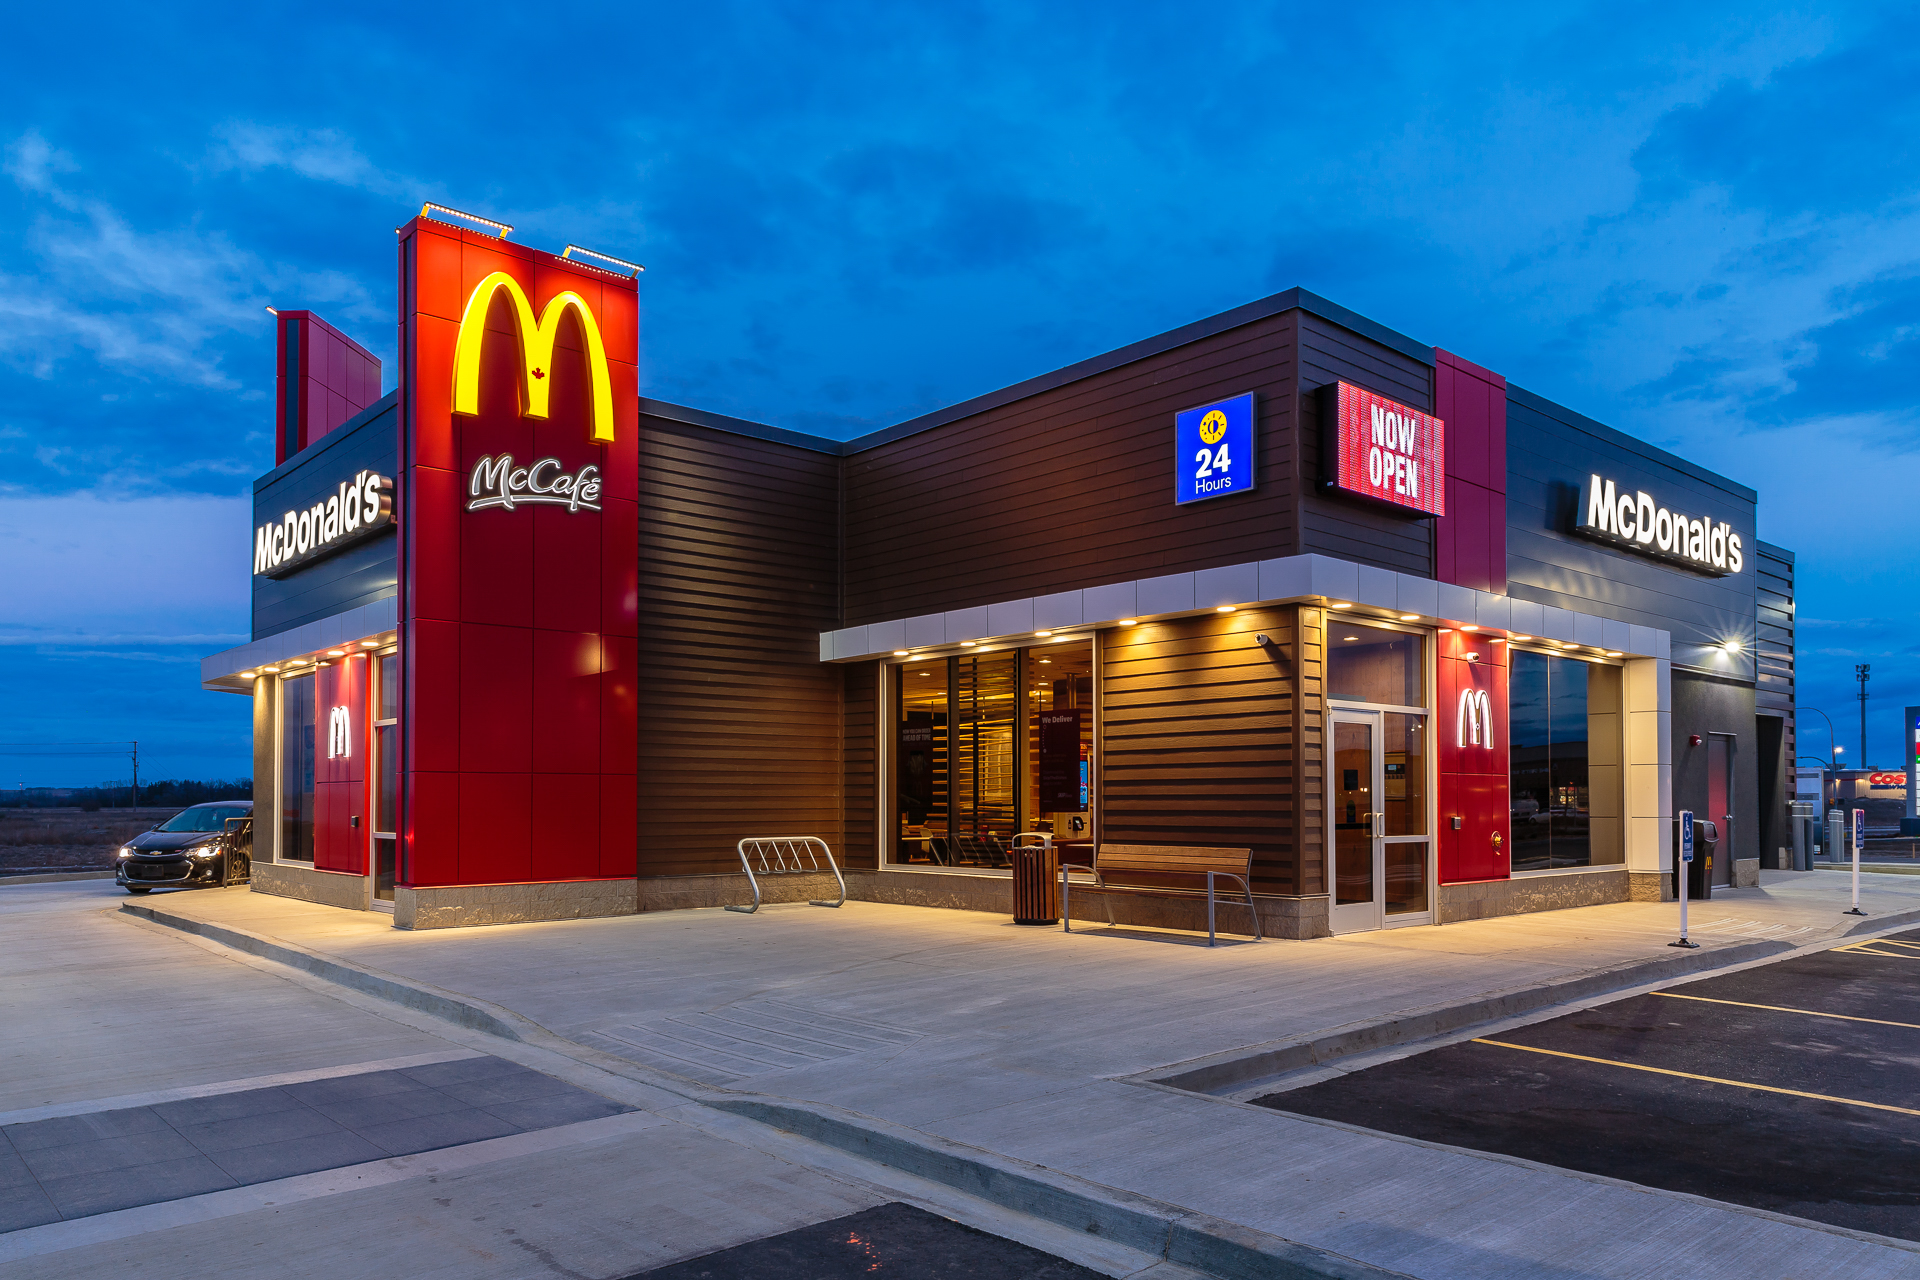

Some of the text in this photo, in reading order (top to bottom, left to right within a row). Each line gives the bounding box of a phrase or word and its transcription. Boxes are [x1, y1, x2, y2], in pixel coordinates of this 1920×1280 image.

[1370, 402, 1416, 457] NOW
[468, 452, 602, 511] McCafé
[1195, 443, 1232, 479] 24
[1195, 476, 1232, 495] Hours
[1369, 446, 1418, 499] OPEN
[254, 469, 381, 575] McDonald's
[1587, 473, 1743, 574] McDonald's
[902, 733, 932, 742] AHEAD OF TIME
[1041, 715, 1073, 724] We Deliver
